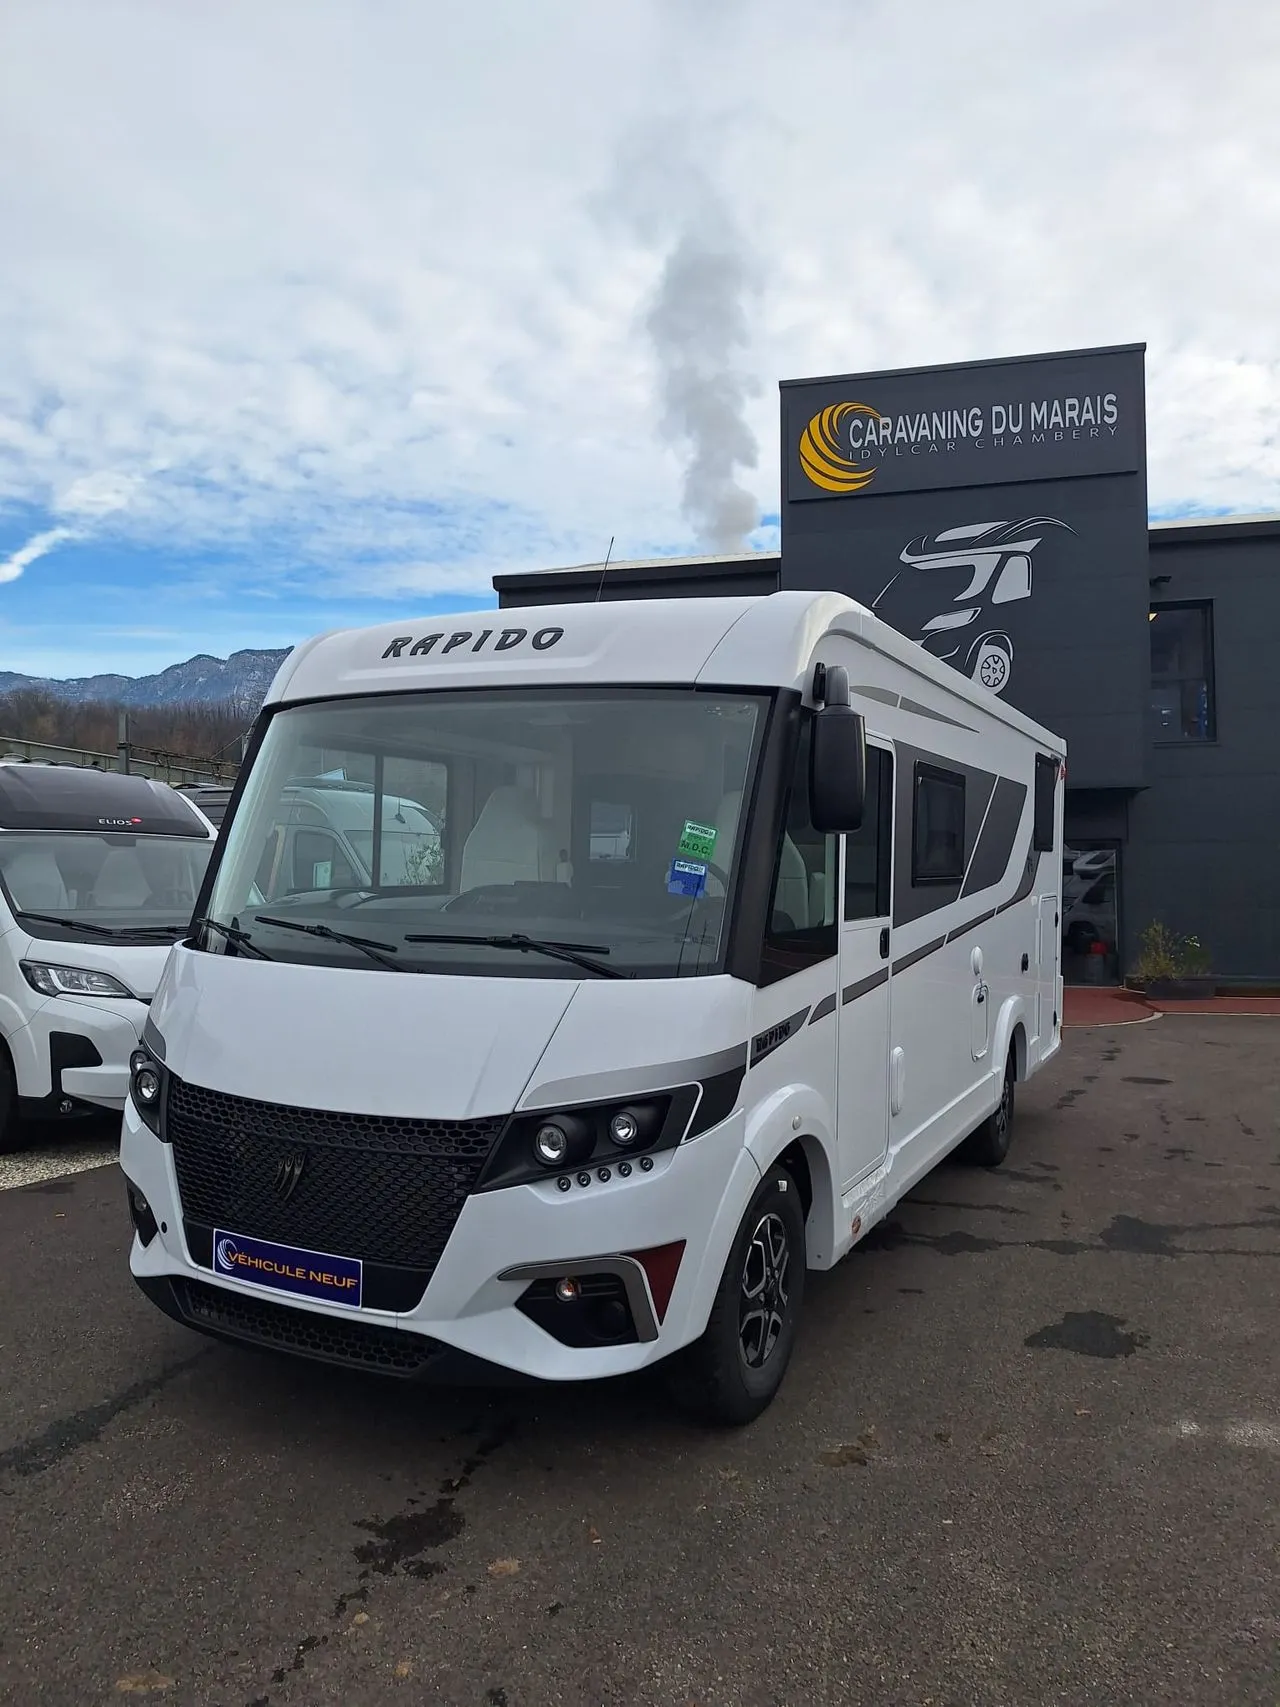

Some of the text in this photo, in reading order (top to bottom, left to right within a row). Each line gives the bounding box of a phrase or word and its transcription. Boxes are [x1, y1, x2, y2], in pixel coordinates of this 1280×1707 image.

[850, 393, 1118, 448] CARAVANING DU MARAIS
[848, 427, 1117, 460] IDYLCAR CHAMBERY
[381, 627, 565, 659] RAPIDO
[98, 818, 133, 826] ELIOS
[228, 1252, 358, 1289] VÉHICULE NEUF
